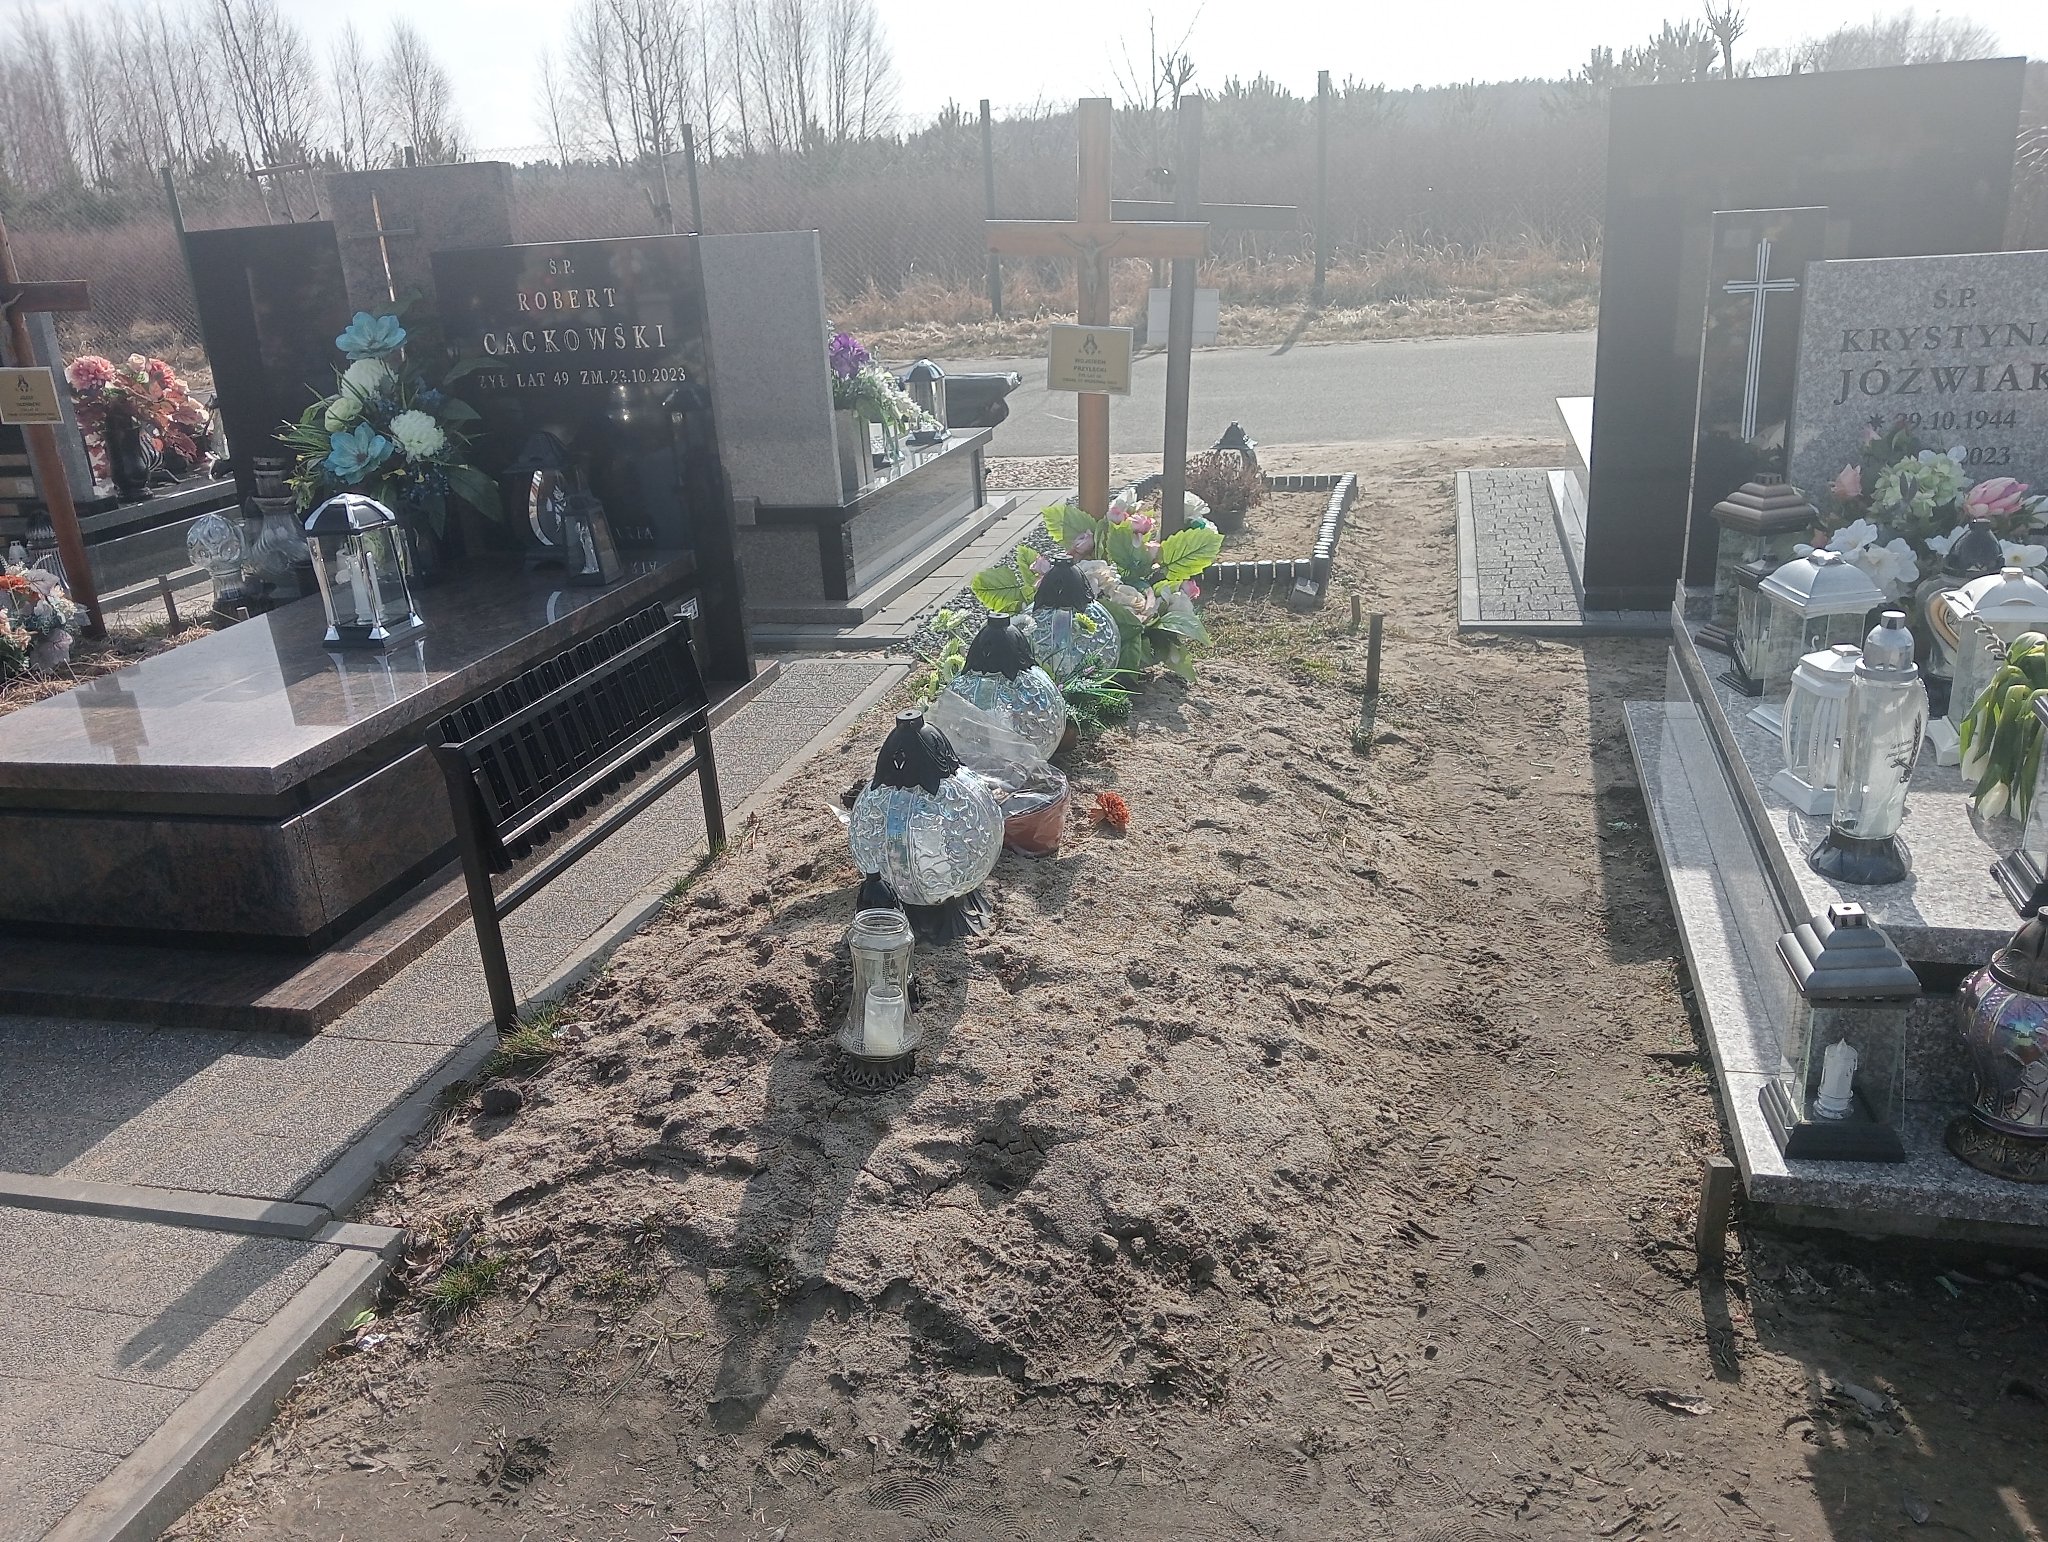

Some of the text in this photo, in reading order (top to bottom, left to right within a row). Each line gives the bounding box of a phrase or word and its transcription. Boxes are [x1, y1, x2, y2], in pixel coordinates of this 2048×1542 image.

[517, 287, 617, 312] ROBERT
[1933, 284, 1977, 309] Ś.P.
[516, 371, 546, 387] LAT
[553, 371, 569, 386] 49
[1833, 360, 2048, 406] JÓŹWIAK
